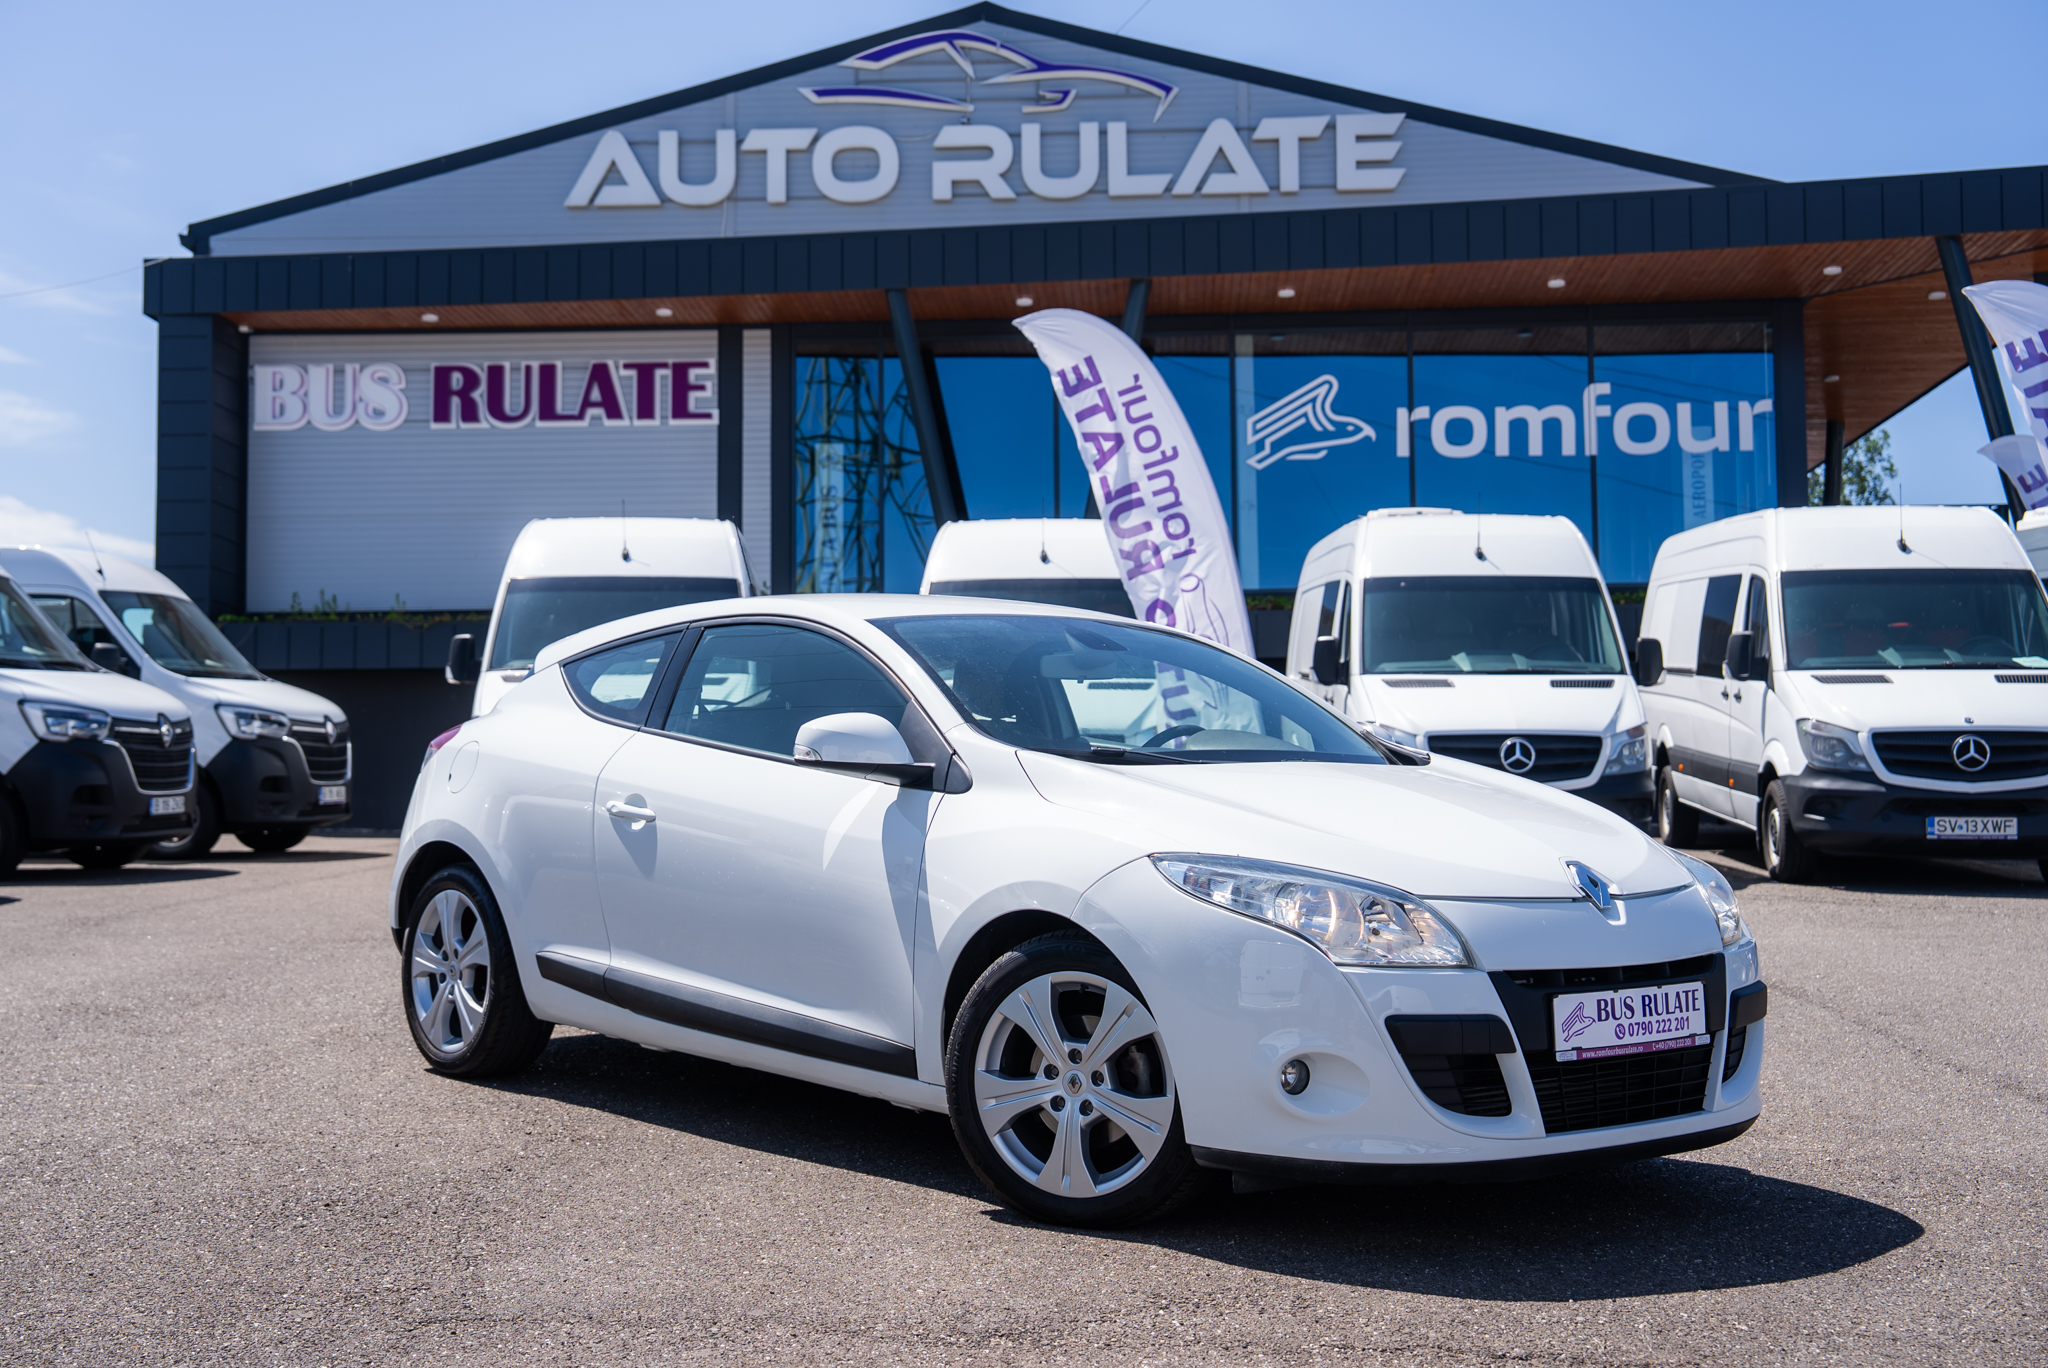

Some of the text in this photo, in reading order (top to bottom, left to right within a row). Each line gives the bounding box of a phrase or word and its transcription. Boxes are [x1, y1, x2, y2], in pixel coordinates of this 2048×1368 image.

[564, 112, 1407, 207] AUTO RULATE
[253, 358, 719, 431] BUS RULATE
[1396, 382, 1774, 458] romfour
[1597, 989, 1700, 1022] BUS RULATE
[1628, 1016, 1690, 1037] 0790 222 201
